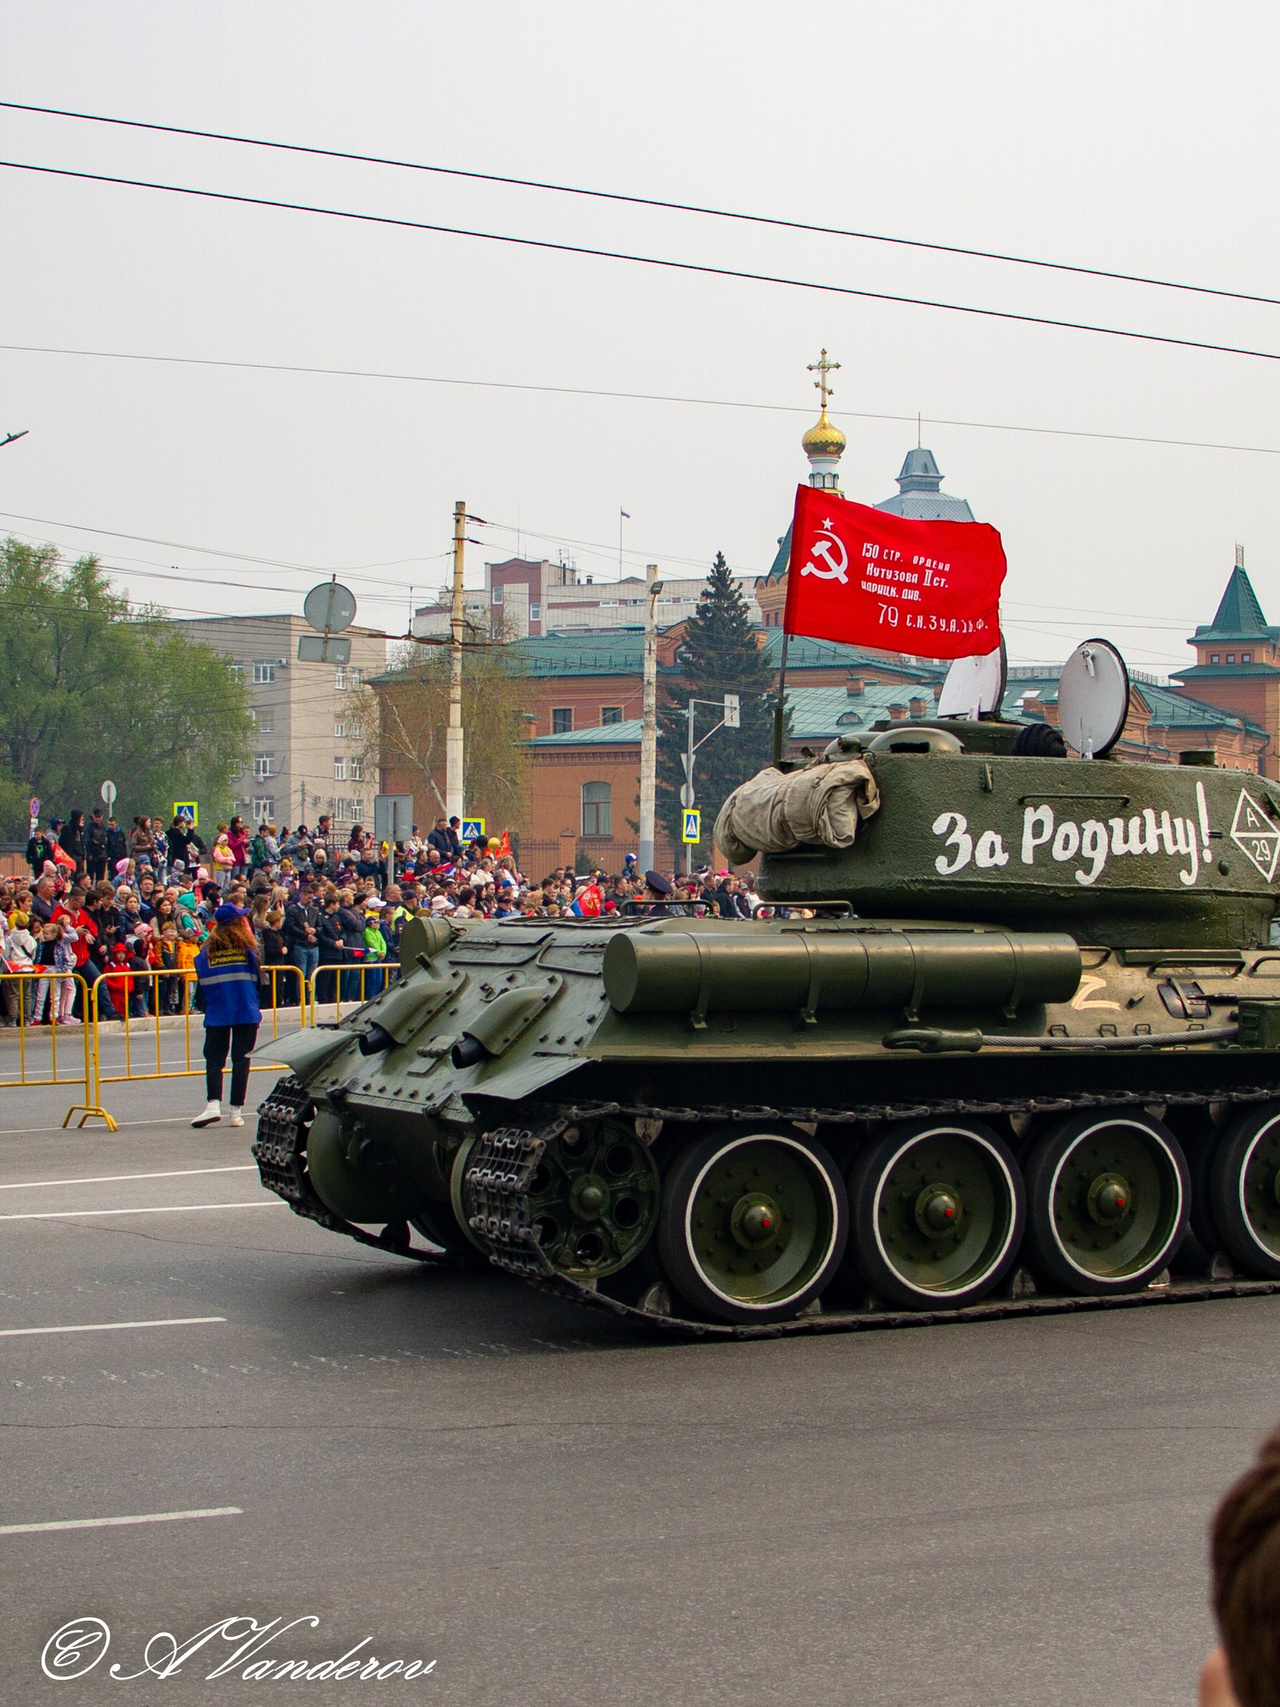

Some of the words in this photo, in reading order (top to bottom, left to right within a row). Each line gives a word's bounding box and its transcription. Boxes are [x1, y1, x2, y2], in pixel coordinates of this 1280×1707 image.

[861, 542, 880, 559] 150
[877, 602, 899, 628] 79
[1246, 807, 1260, 827] А
[932, 812, 1010, 876] За
[1021, 781, 1213, 886] Родину!
[1251, 839, 1271, 861] 29
